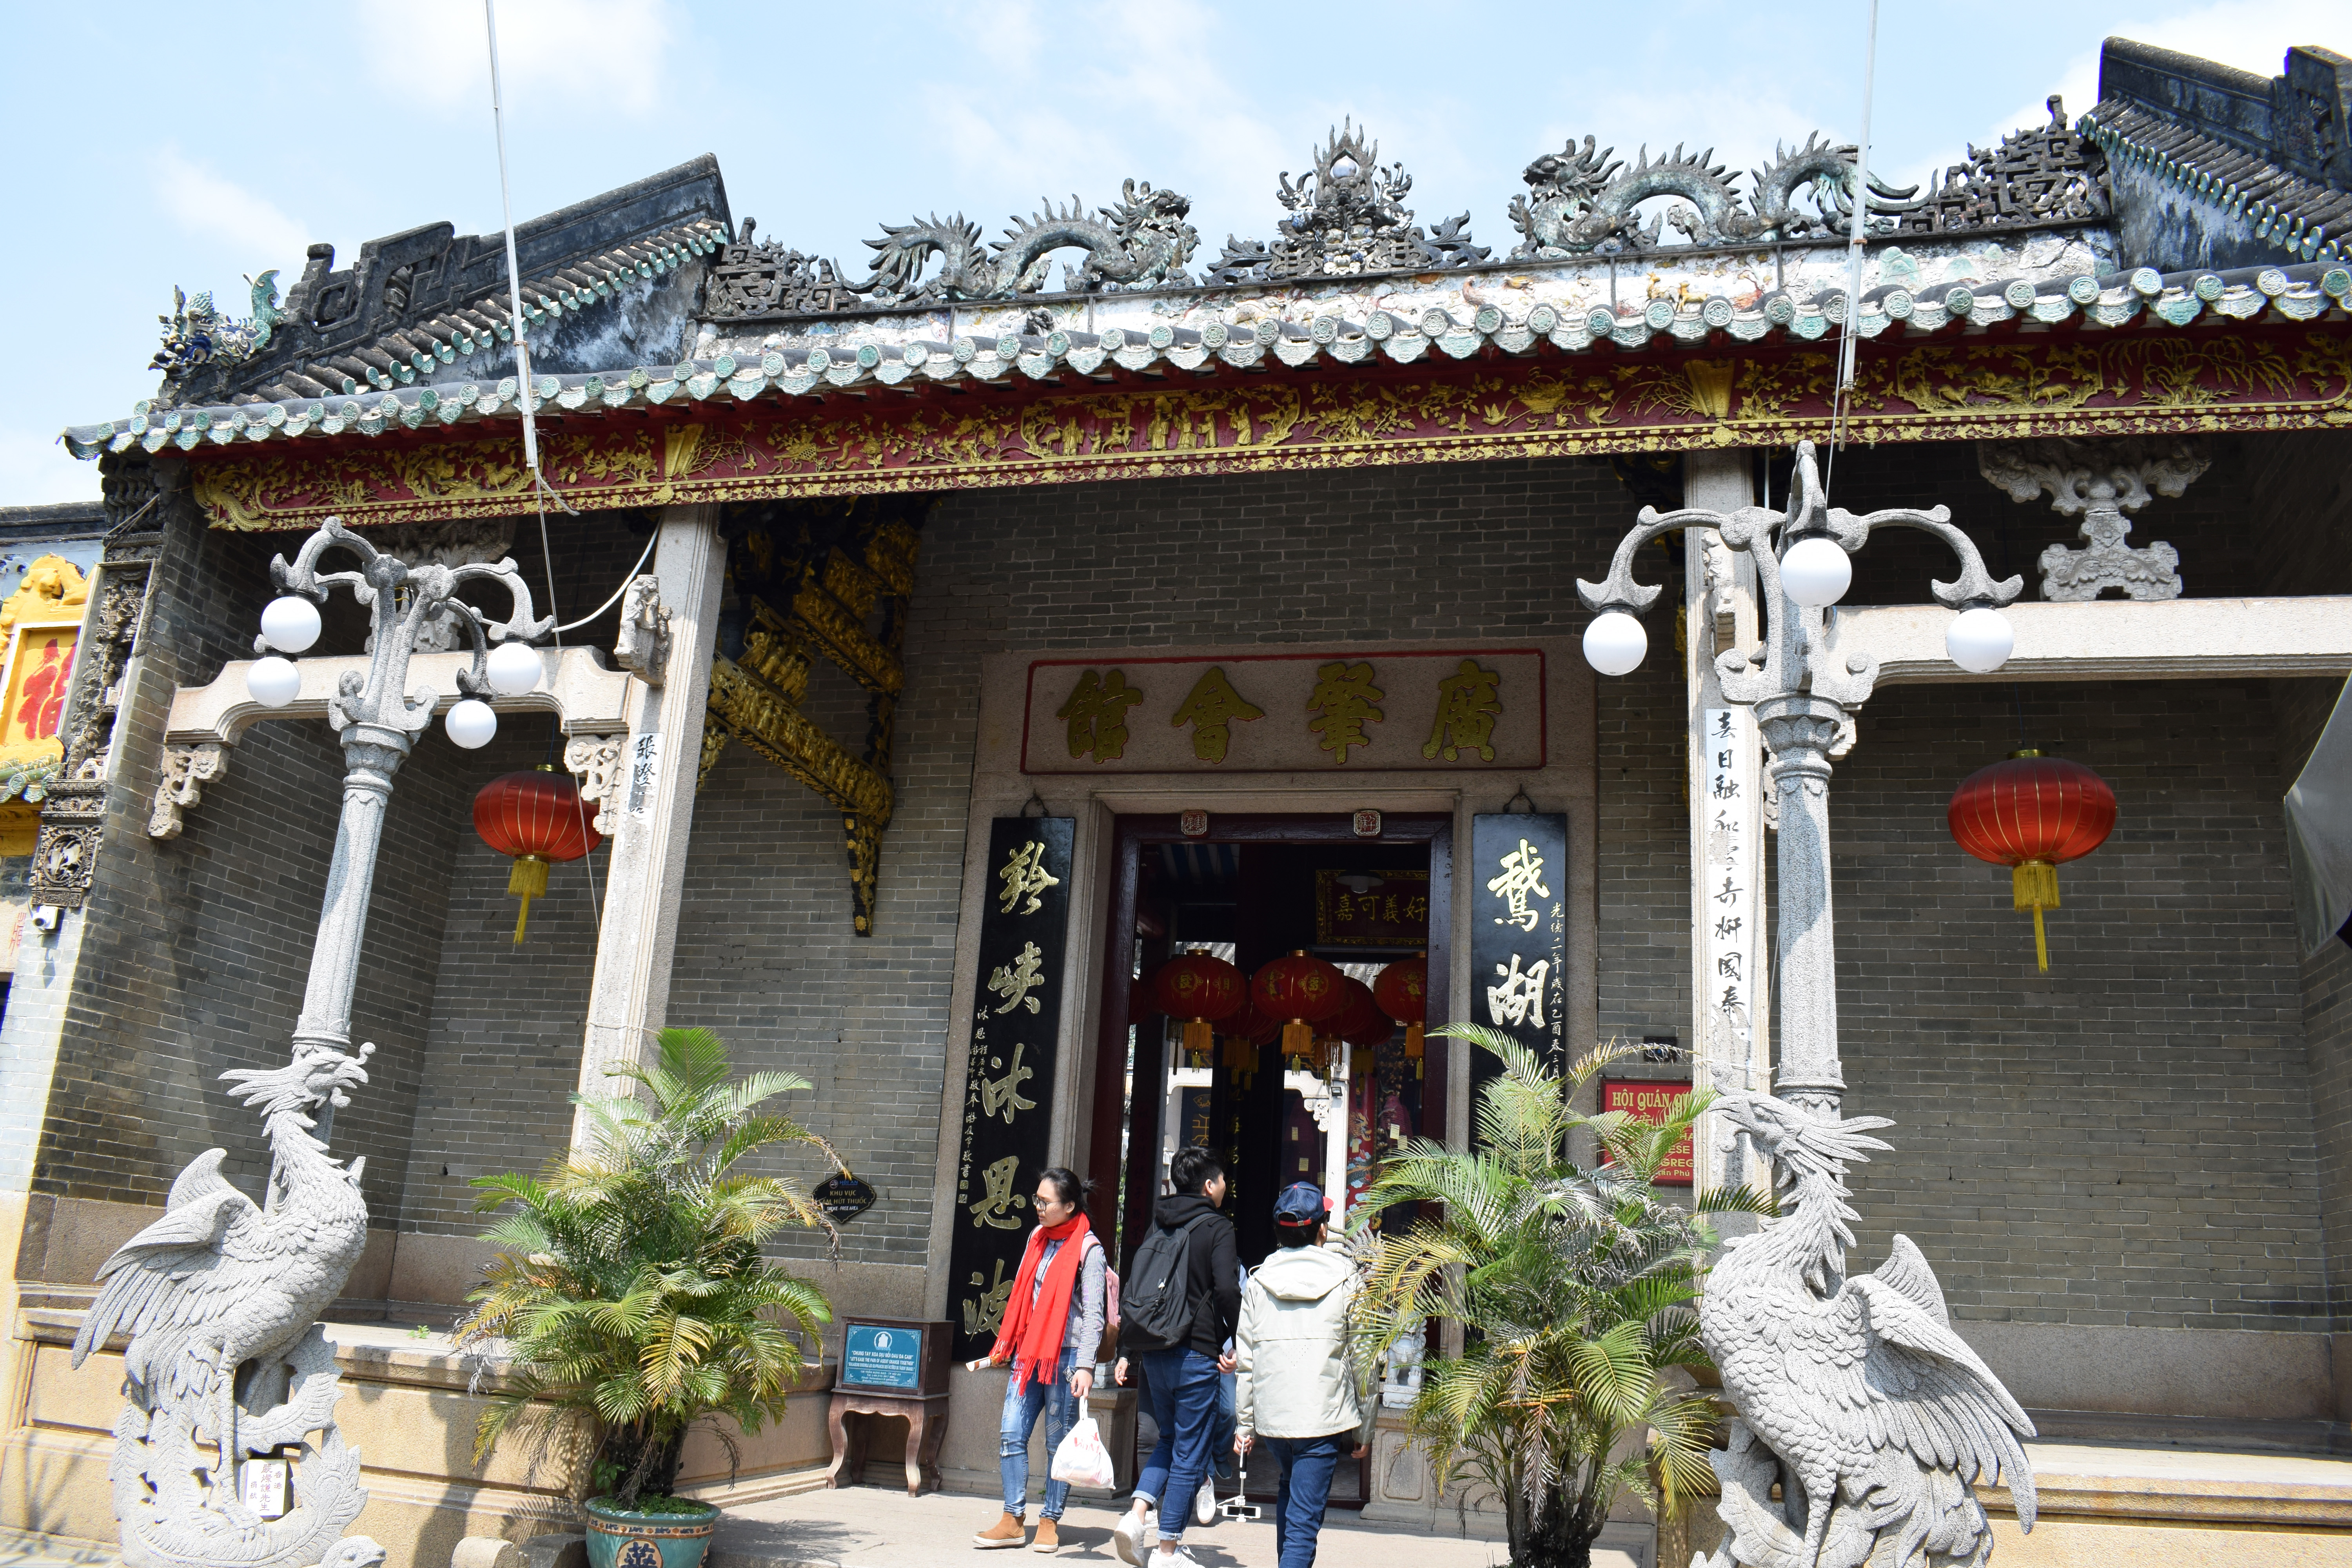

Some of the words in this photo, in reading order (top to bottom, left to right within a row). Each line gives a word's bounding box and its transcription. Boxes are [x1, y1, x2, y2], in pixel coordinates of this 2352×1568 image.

[1612, 1088, 1633, 1110] HỘI
[1637, 1089, 1670, 1111] QUÁN
[847, 1196, 867, 1204] THUỐC
